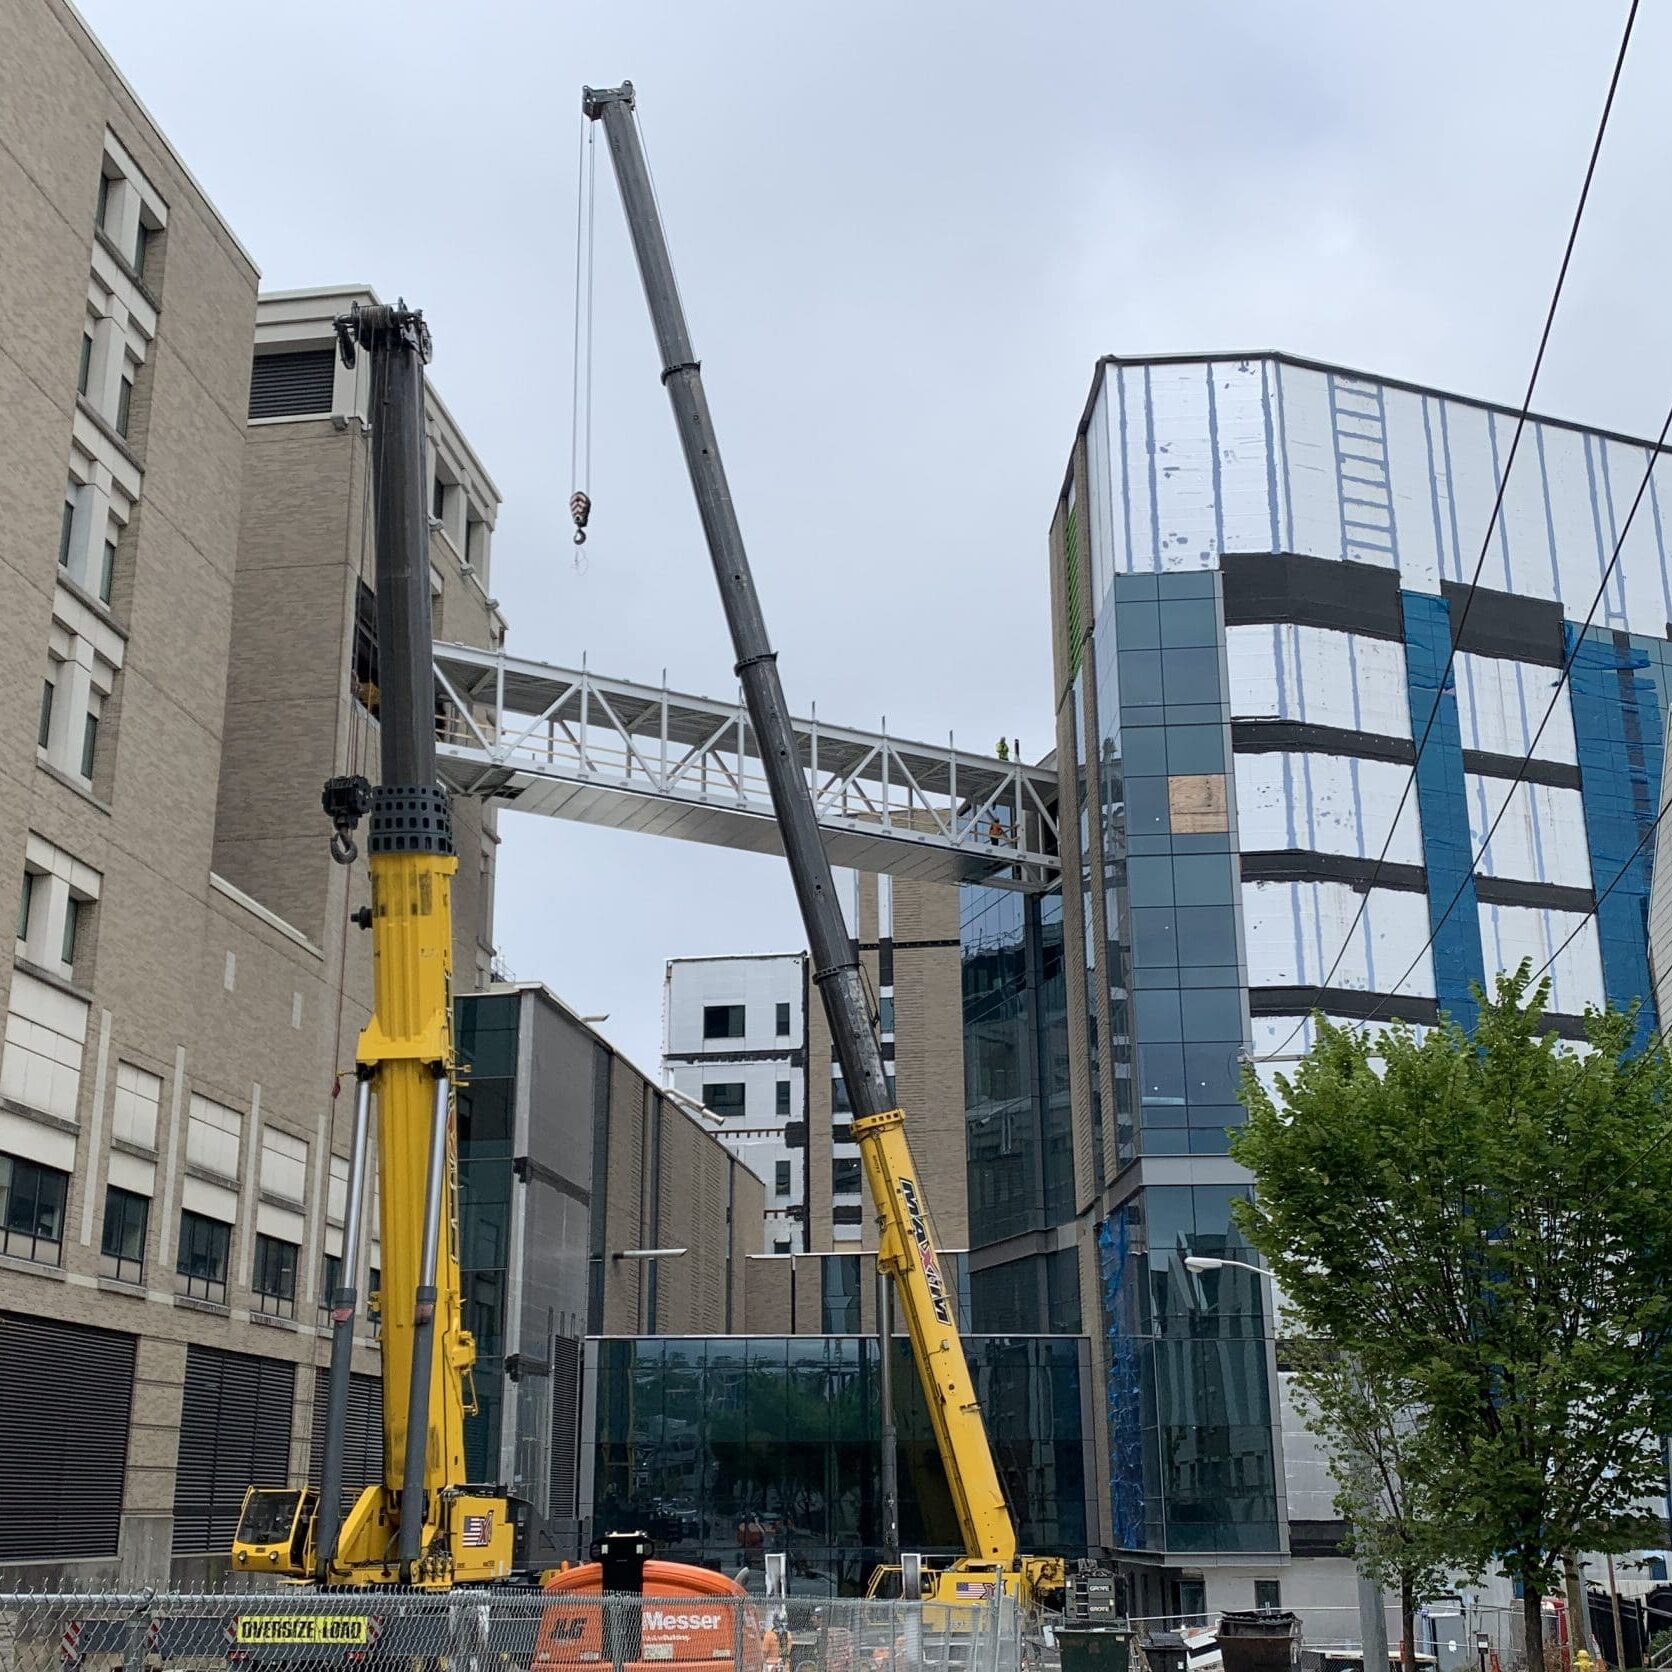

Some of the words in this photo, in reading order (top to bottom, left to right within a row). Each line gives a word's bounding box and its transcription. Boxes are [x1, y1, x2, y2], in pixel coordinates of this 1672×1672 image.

[900, 1180, 950, 1324] MAXIM
[241, 1621, 315, 1639] OVERSIZE
[322, 1621, 362, 1639] LOAD
[642, 1611, 721, 1630] Messer
